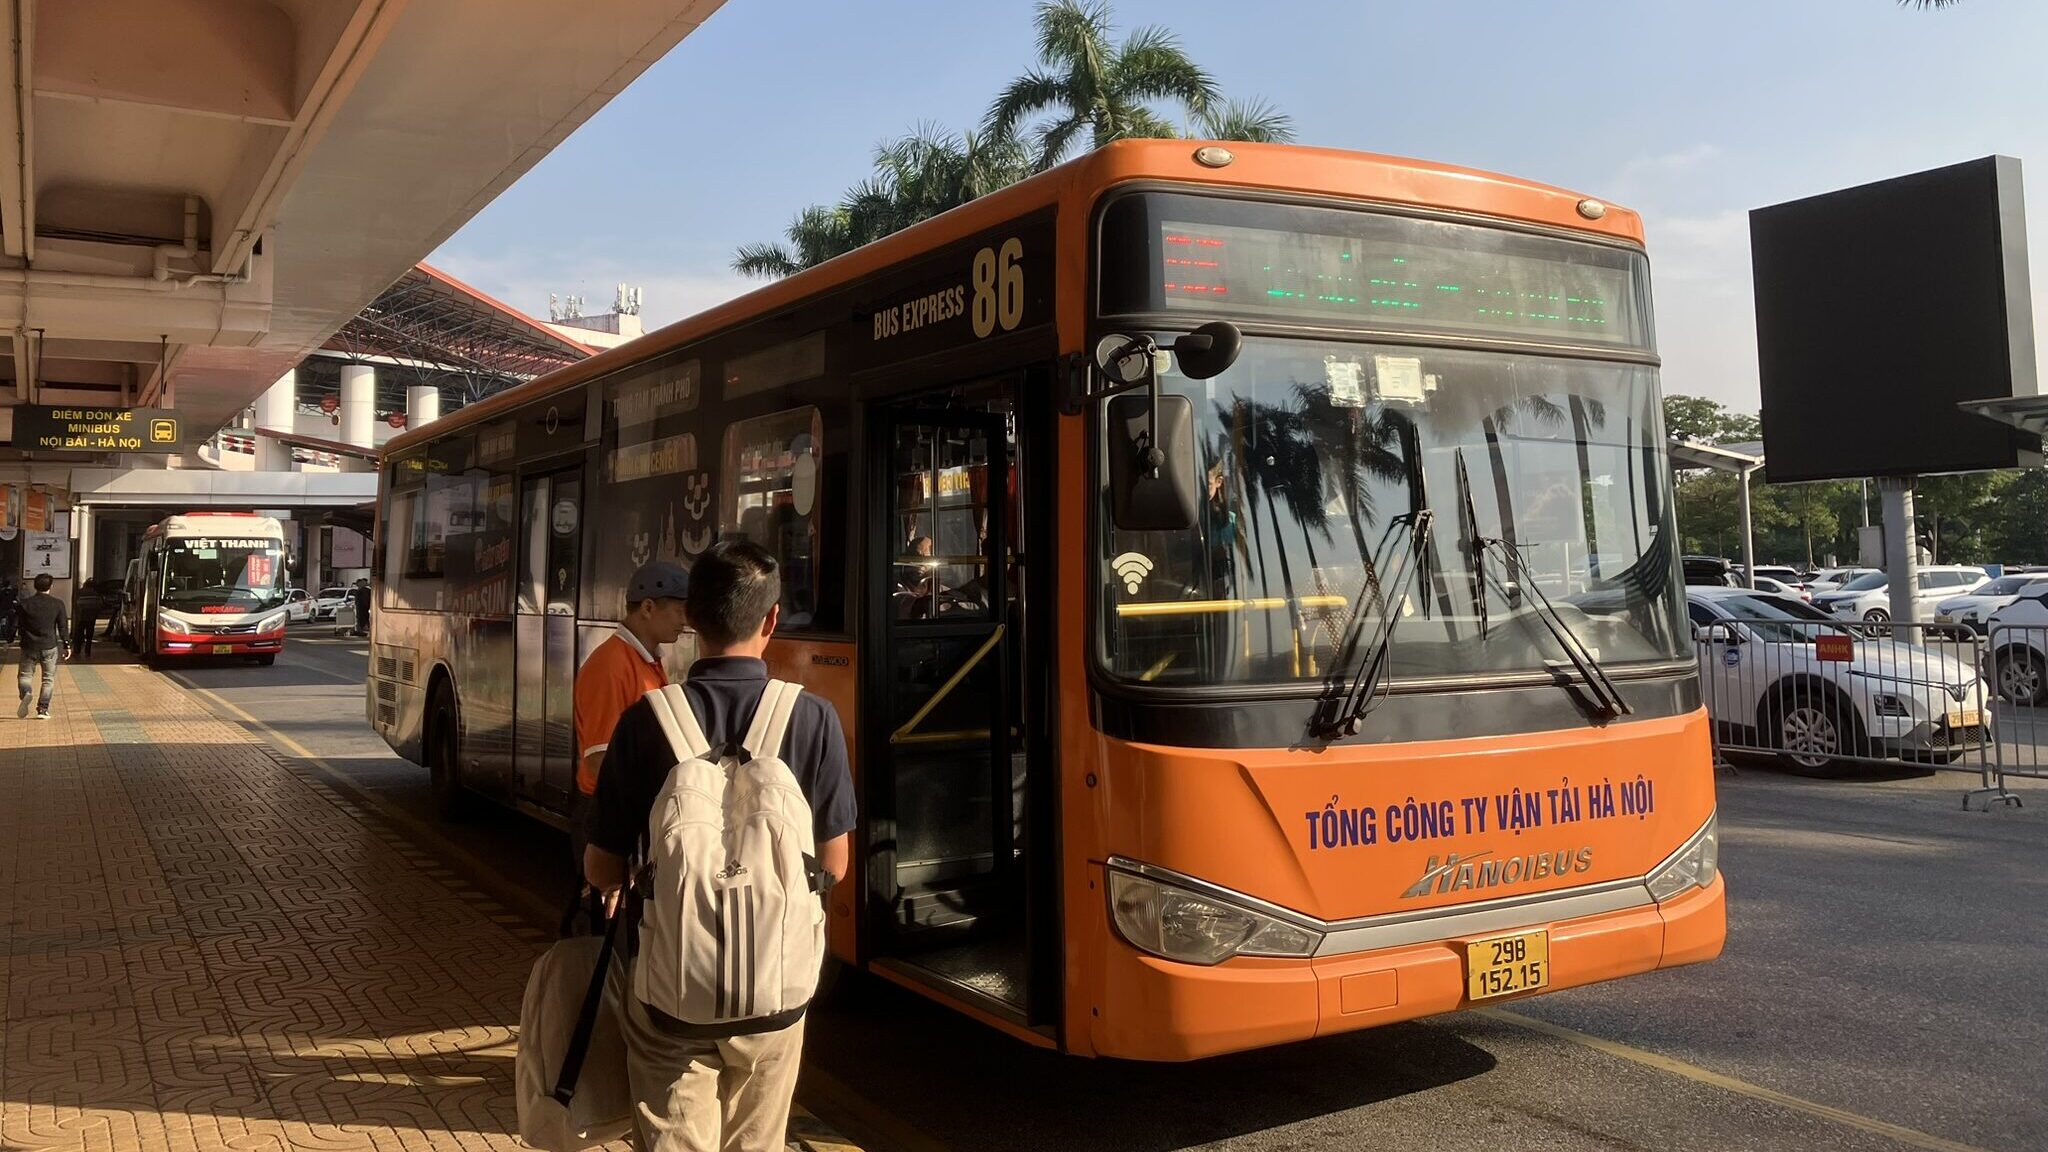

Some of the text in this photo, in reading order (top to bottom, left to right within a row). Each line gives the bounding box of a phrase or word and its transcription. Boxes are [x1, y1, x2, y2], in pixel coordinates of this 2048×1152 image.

[874, 237, 1024, 340] BUS EXPRESS 86
[86, 410, 112, 420] ĐÓN
[115, 411, 132, 421] XE
[68, 423, 120, 434] MINIBUS
[40, 435, 62, 448] NỘI
[65, 435, 87, 447] BÀI
[98, 436, 116, 448] HÀ
[119, 437, 141, 450] NỘI
[184, 537, 270, 550] VIỆT THANH
[812, 655, 849, 666] DAEWOO
[1305, 774, 1654, 850] TỔNG CÔNG TY VẬN TẢI HÀ NỘI
[1491, 938, 1526, 966] 29B
[1480, 962, 1541, 995] 152.15
